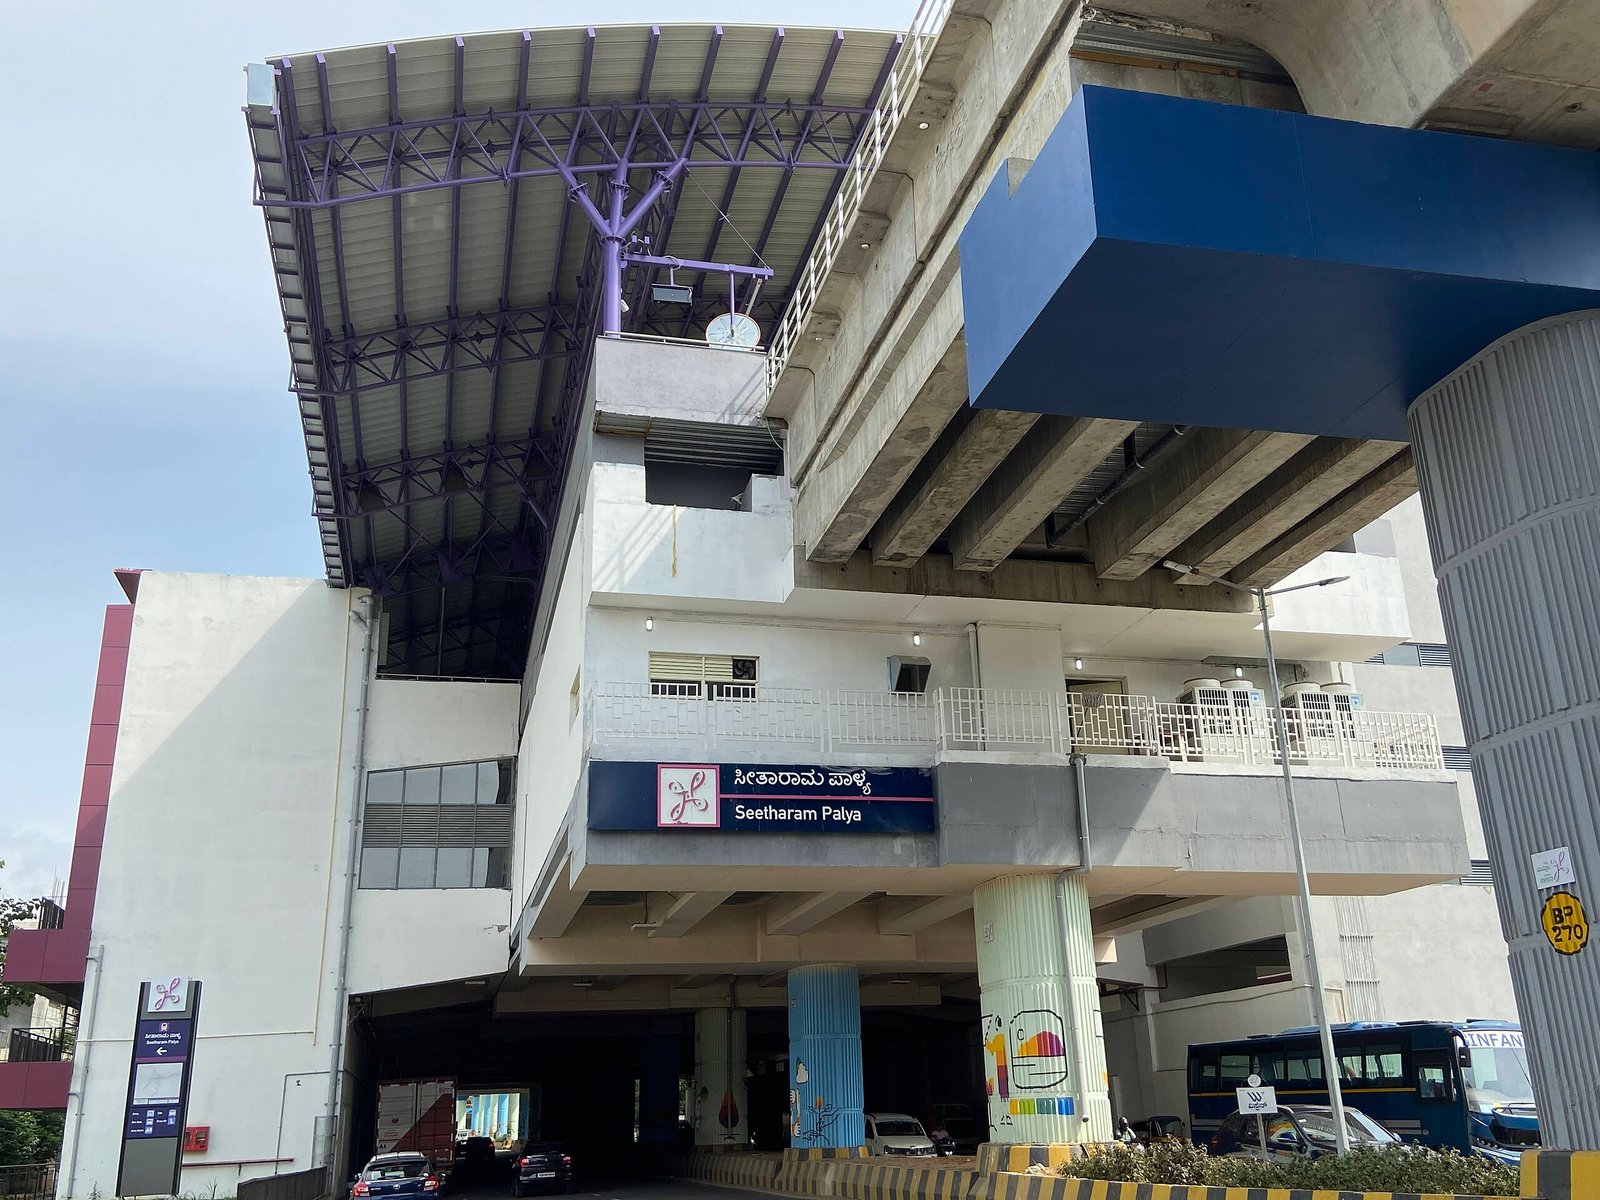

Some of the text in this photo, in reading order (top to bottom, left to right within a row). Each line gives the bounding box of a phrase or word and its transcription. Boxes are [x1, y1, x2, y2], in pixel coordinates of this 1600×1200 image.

[734, 768, 873, 796] ಸೀತಾರಾಮ ಪಾಳ್ಯ
[735, 805, 862, 825] Seetharam Palya
[1552, 905, 1574, 925] BP
[1552, 924, 1583, 942] 270
[1464, 1033, 1525, 1047] INFAN
